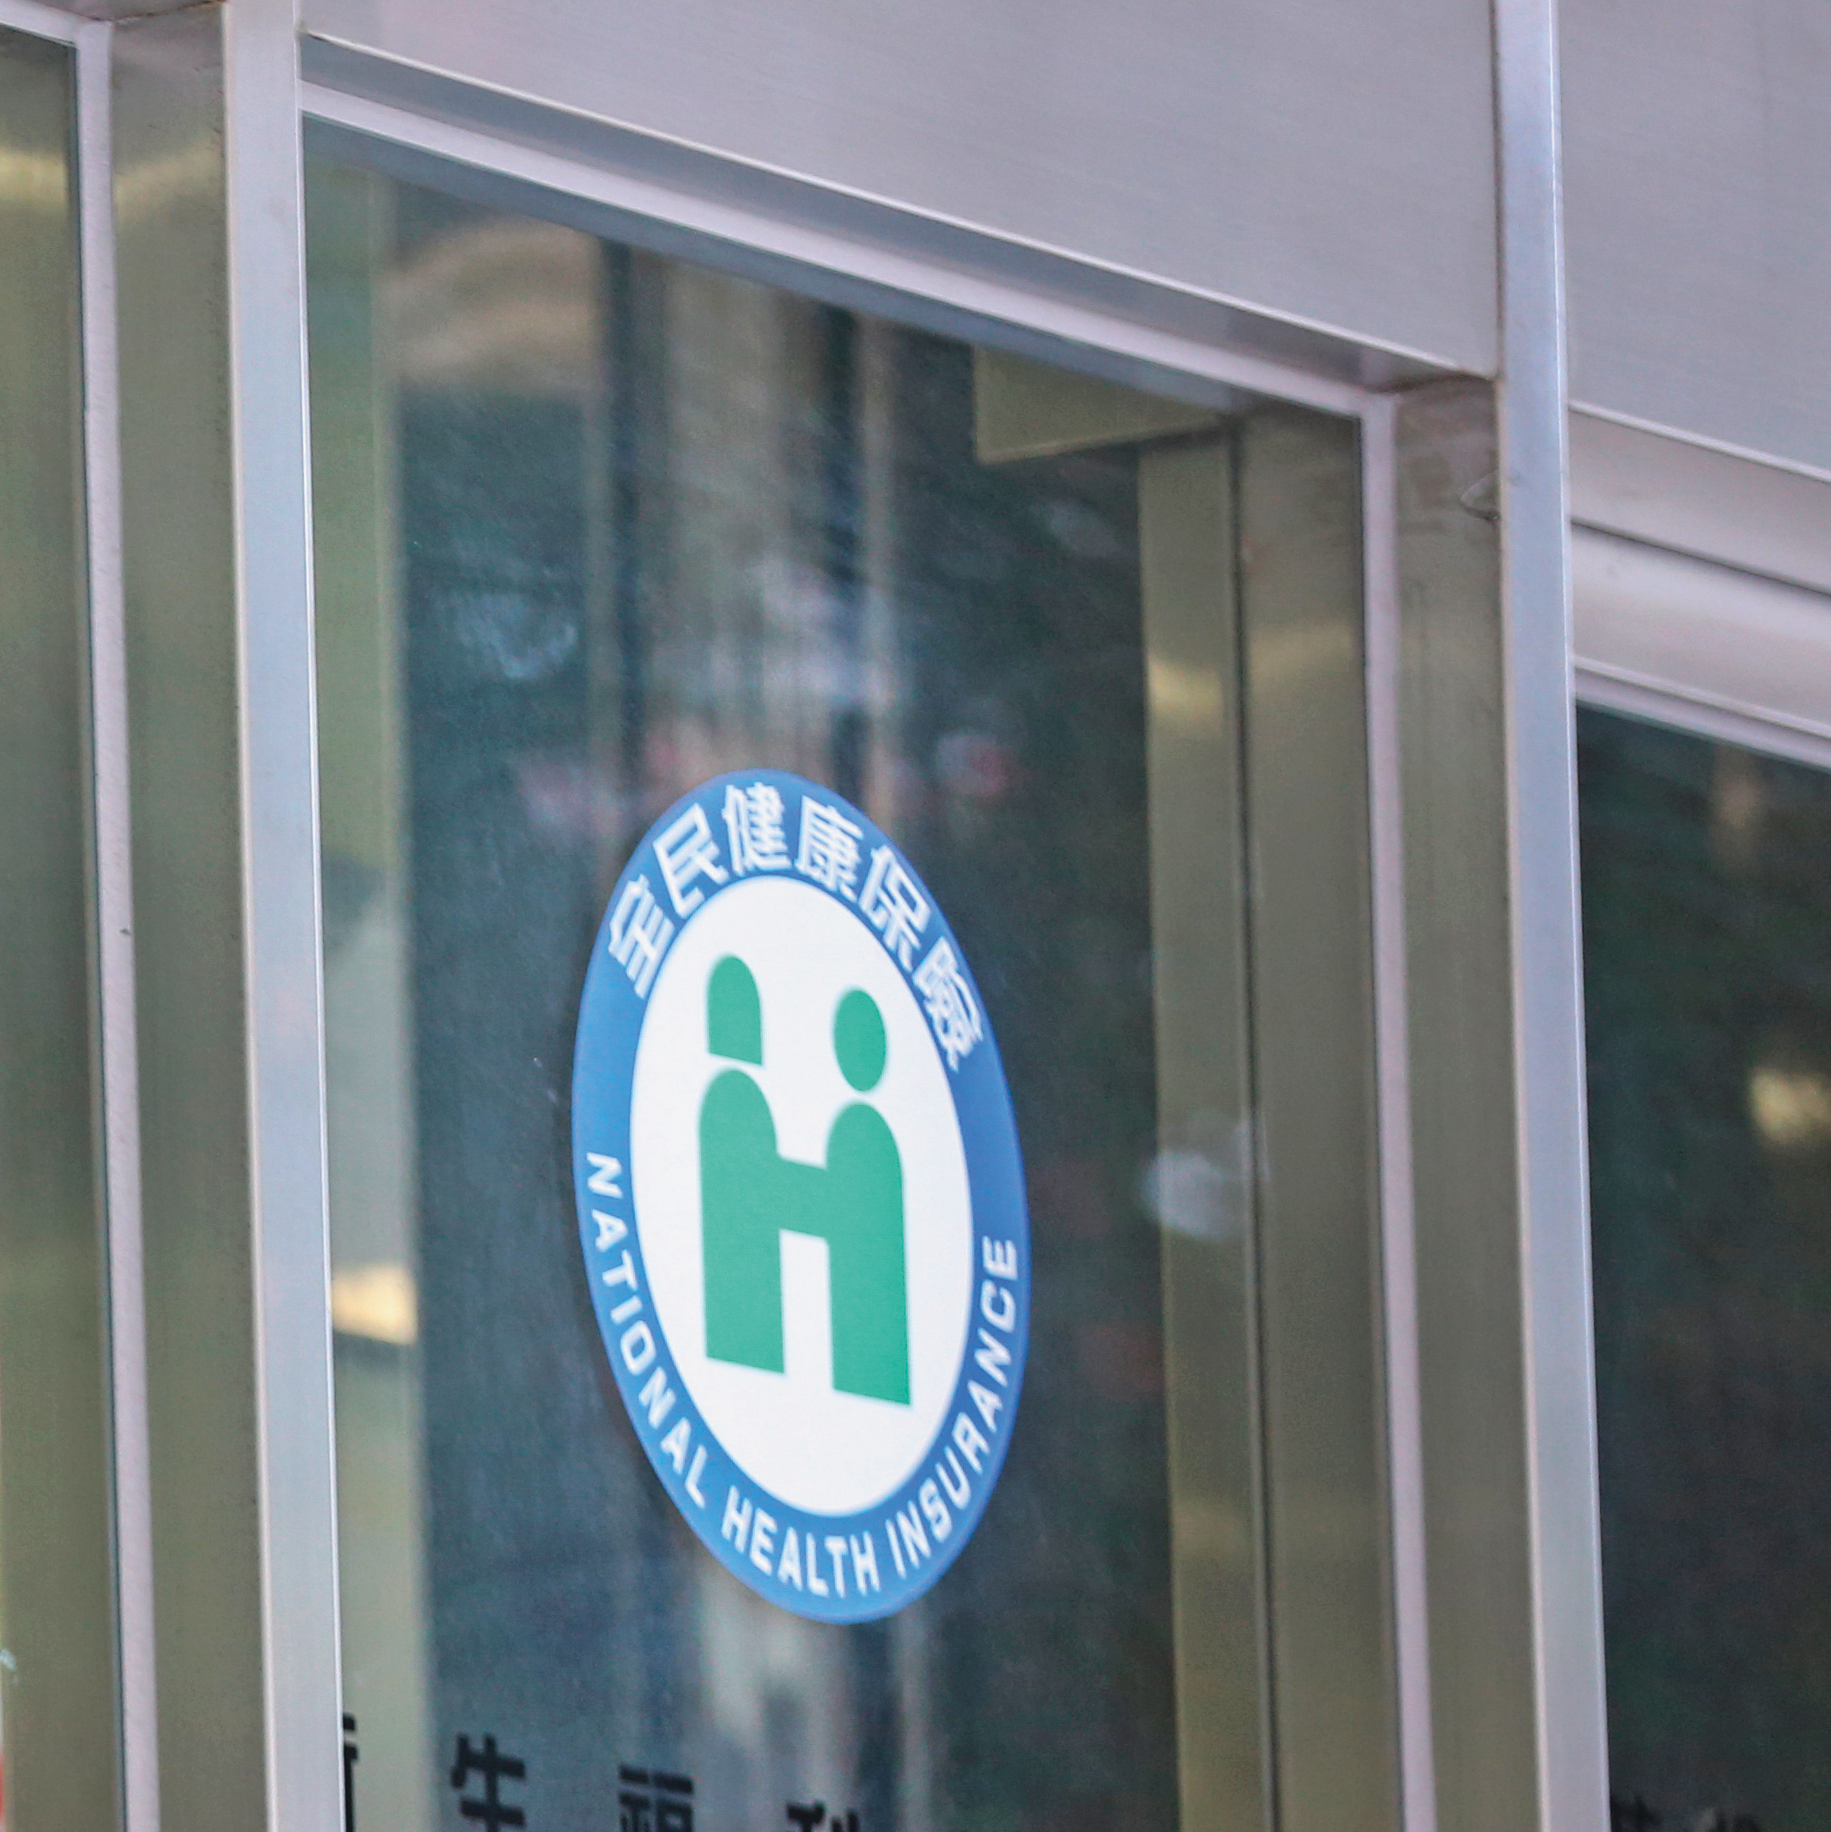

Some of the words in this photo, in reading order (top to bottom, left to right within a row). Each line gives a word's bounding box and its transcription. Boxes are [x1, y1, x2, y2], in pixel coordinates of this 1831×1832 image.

[608, 782, 984, 1071] 全民健康保險
[587, 1152, 706, 1509] NATIONAL
[723, 1488, 879, 1598] HEALTH
[887, 1238, 1017, 1577] INSURANCE
